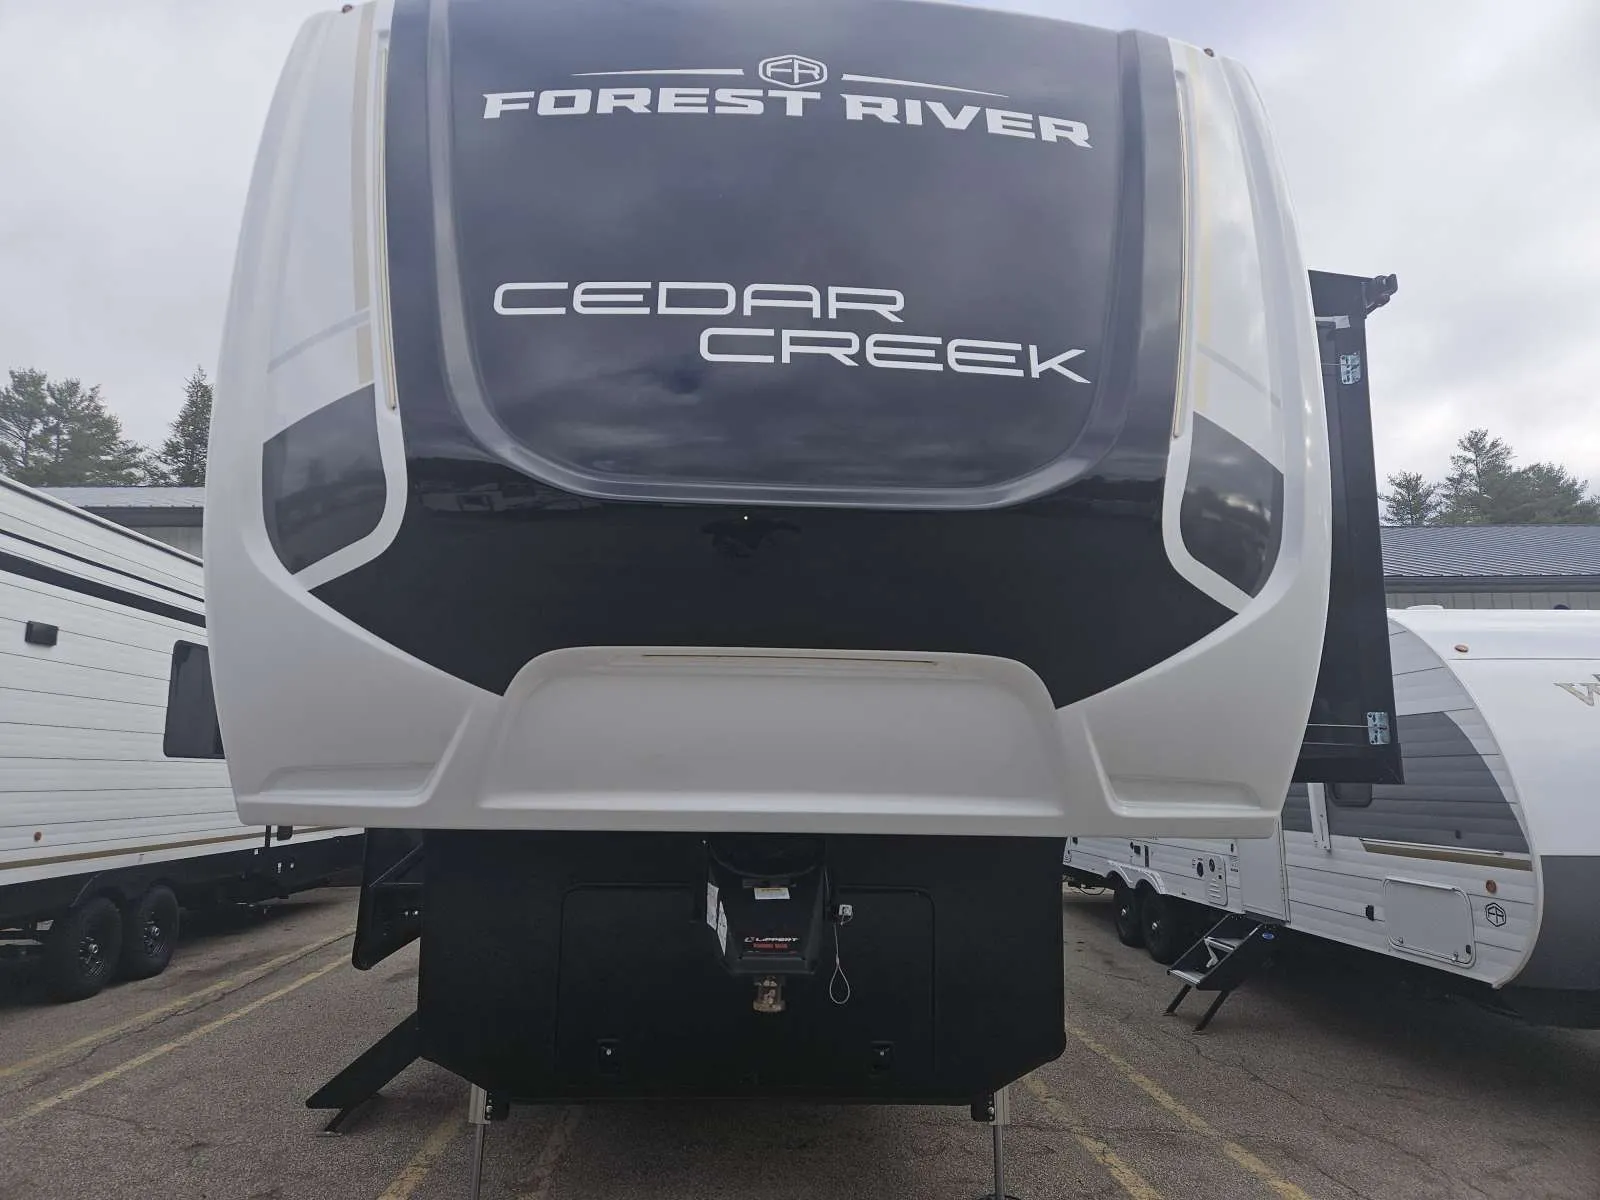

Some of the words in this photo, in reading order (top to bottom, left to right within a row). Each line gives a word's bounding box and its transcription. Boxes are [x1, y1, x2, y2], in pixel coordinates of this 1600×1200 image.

[483, 87, 821, 119] FOREST
[840, 93, 1093, 149] RIVER
[493, 281, 905, 323] CEDAR
[699, 327, 1092, 384] CREEK
